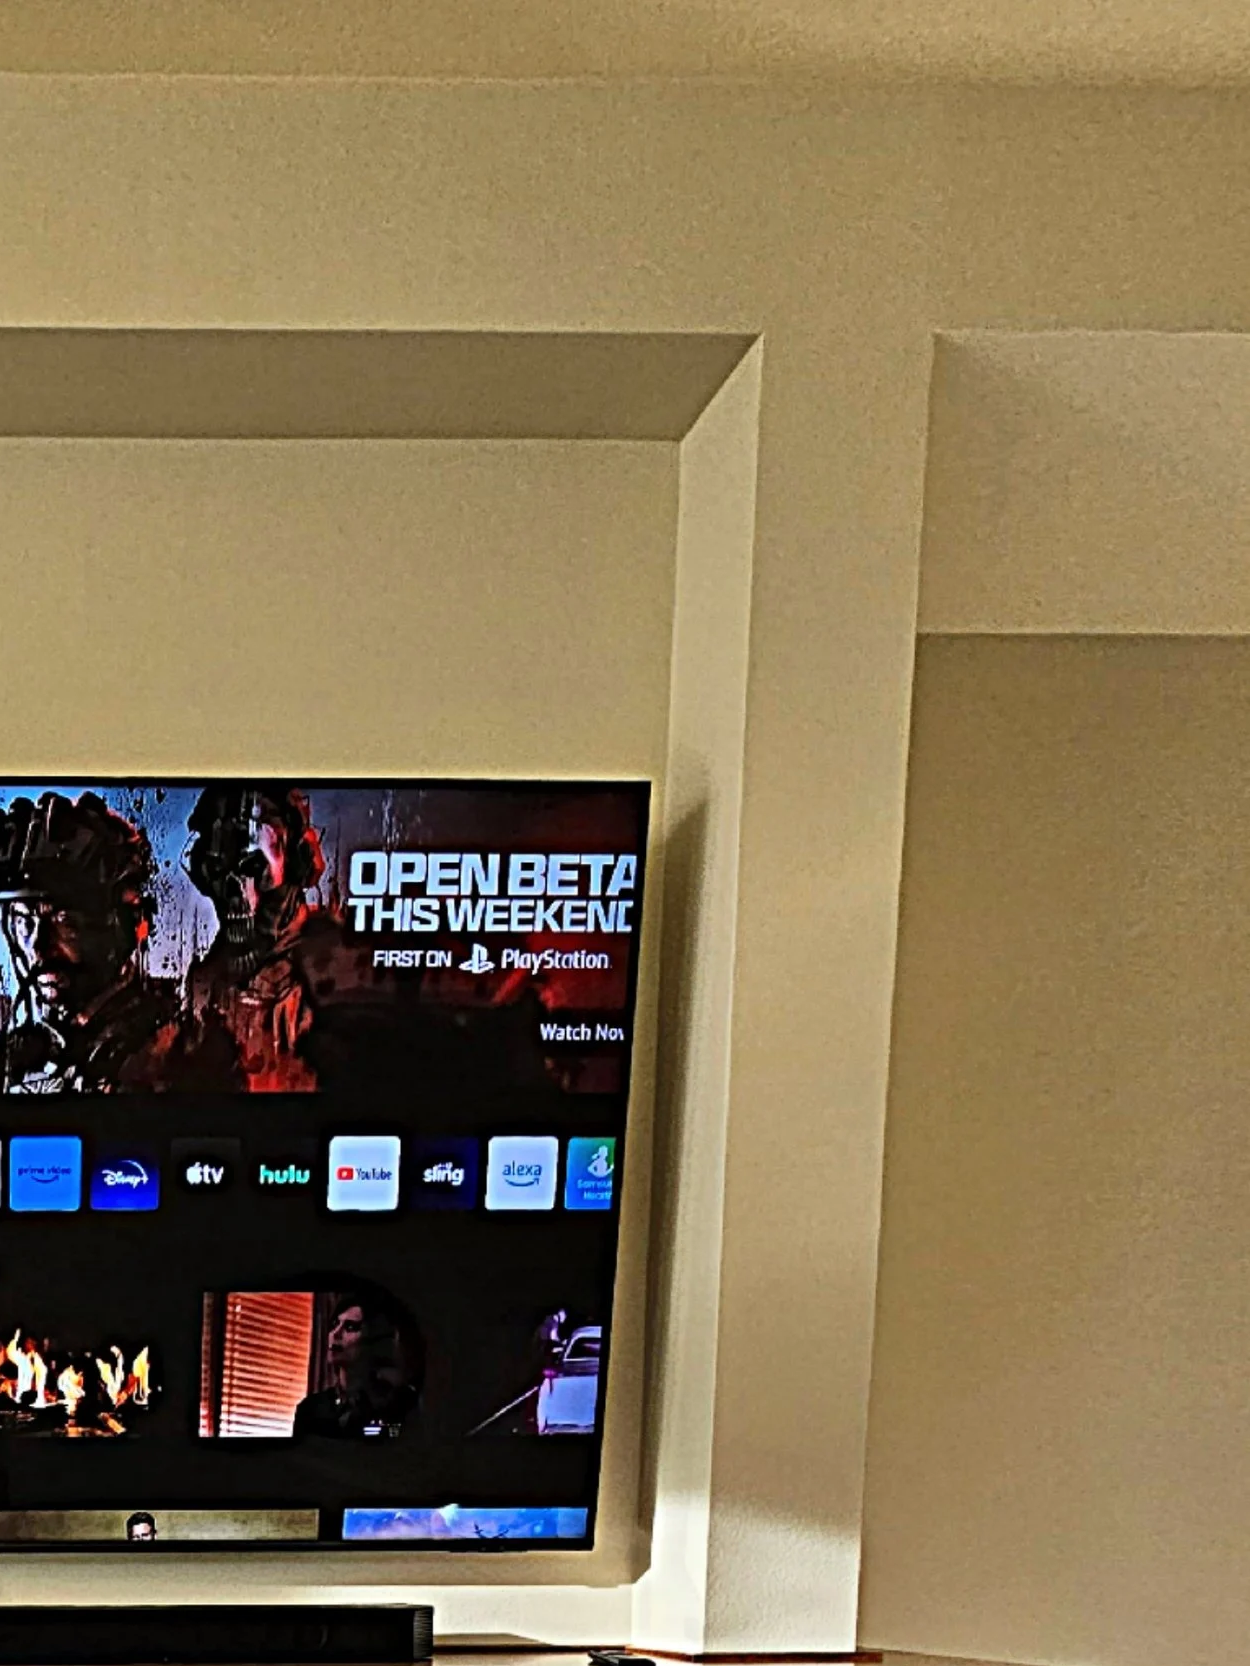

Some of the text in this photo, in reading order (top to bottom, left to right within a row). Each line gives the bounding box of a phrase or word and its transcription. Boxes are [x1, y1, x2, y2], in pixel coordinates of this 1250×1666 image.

[349, 851, 637, 897] OPEN BETA
[348, 898, 440, 932] THIS
[373, 949, 610, 975] FIRST ON PlayStation
[540, 1024, 591, 1041] Watch
[259, 1165, 310, 1184] hulu
[355, 1167, 392, 1181] YouTube
[423, 1162, 465, 1186] sling
[502, 1161, 543, 1177] alexa
